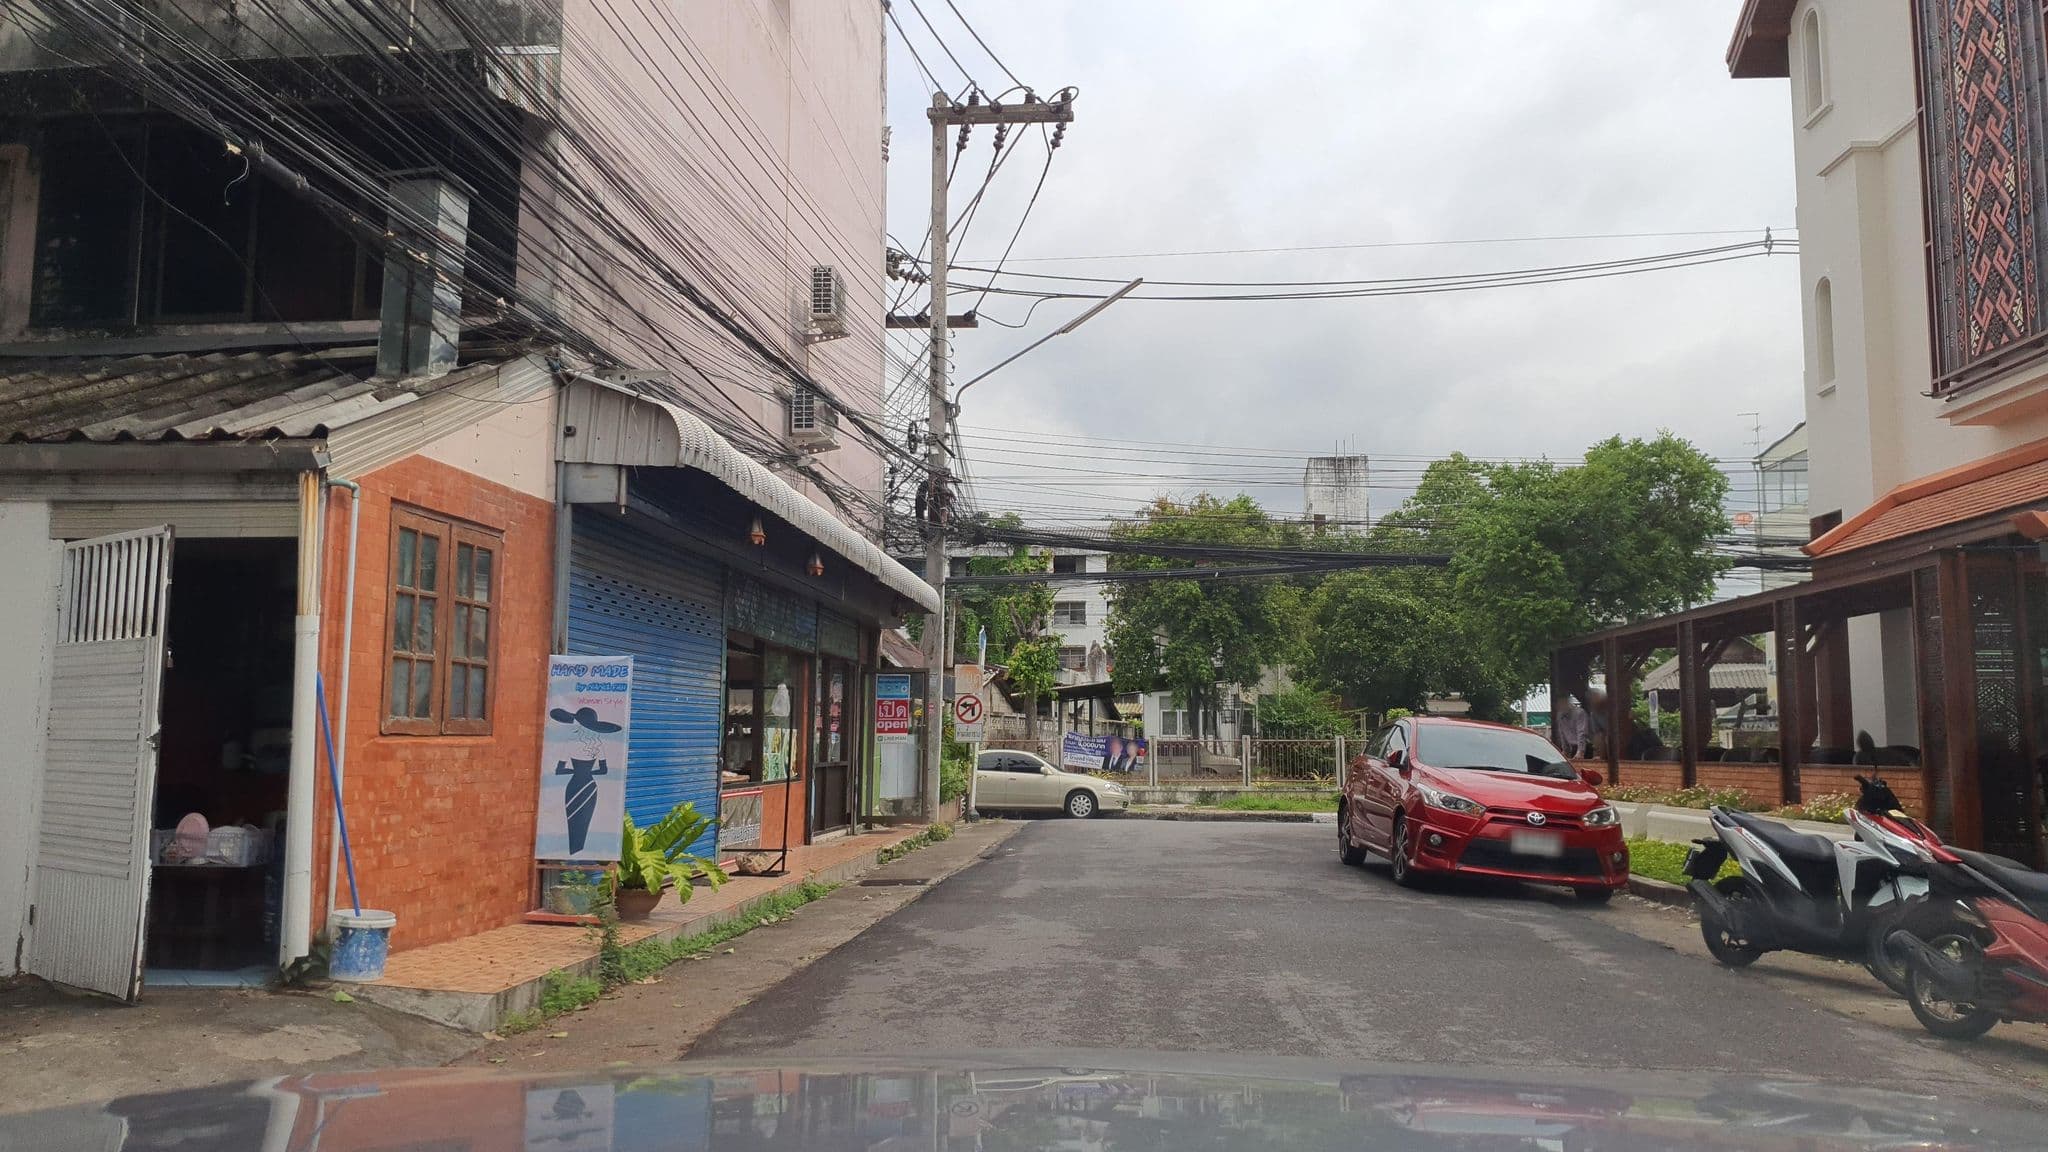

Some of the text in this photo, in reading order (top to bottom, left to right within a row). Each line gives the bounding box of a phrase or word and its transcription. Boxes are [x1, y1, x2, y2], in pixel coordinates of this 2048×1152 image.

[551, 664, 629, 677] HAND MADE
[878, 700, 907, 718] เปิด
[877, 721, 908, 731] open
